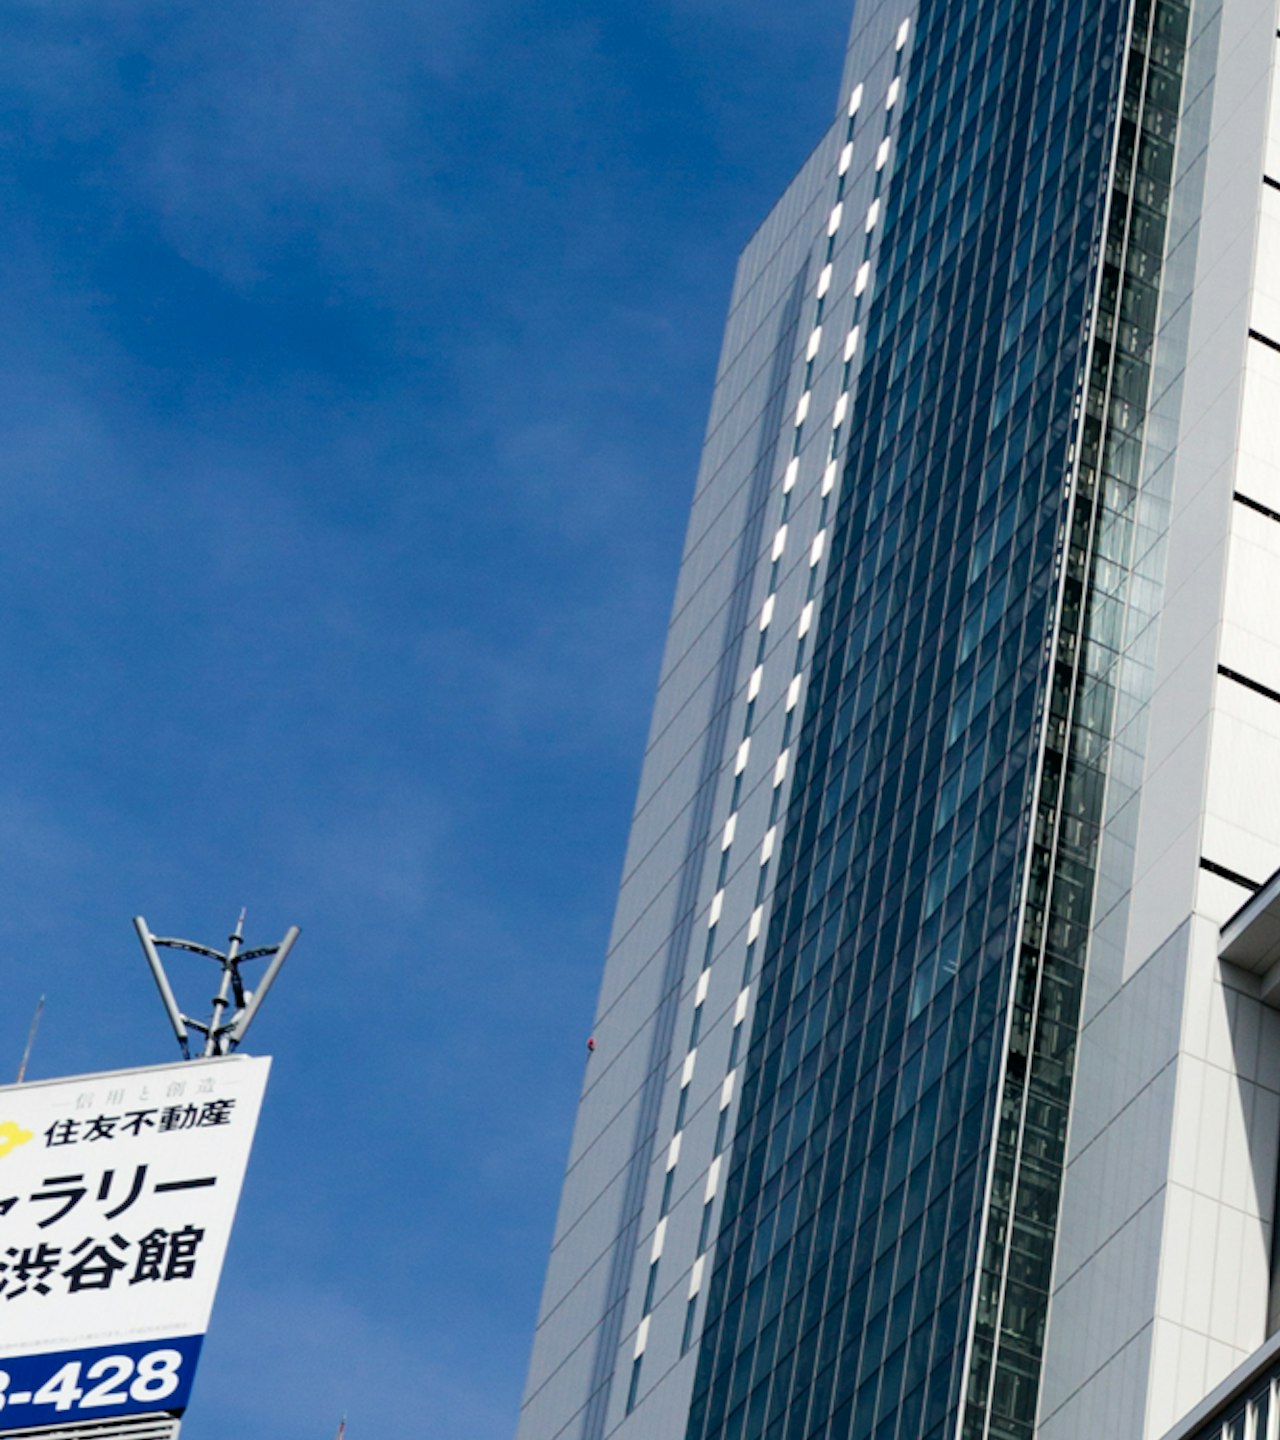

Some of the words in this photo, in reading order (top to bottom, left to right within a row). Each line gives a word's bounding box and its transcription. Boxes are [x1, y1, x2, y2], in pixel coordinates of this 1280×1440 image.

[44, 1098, 236, 1148] 住友不動産
